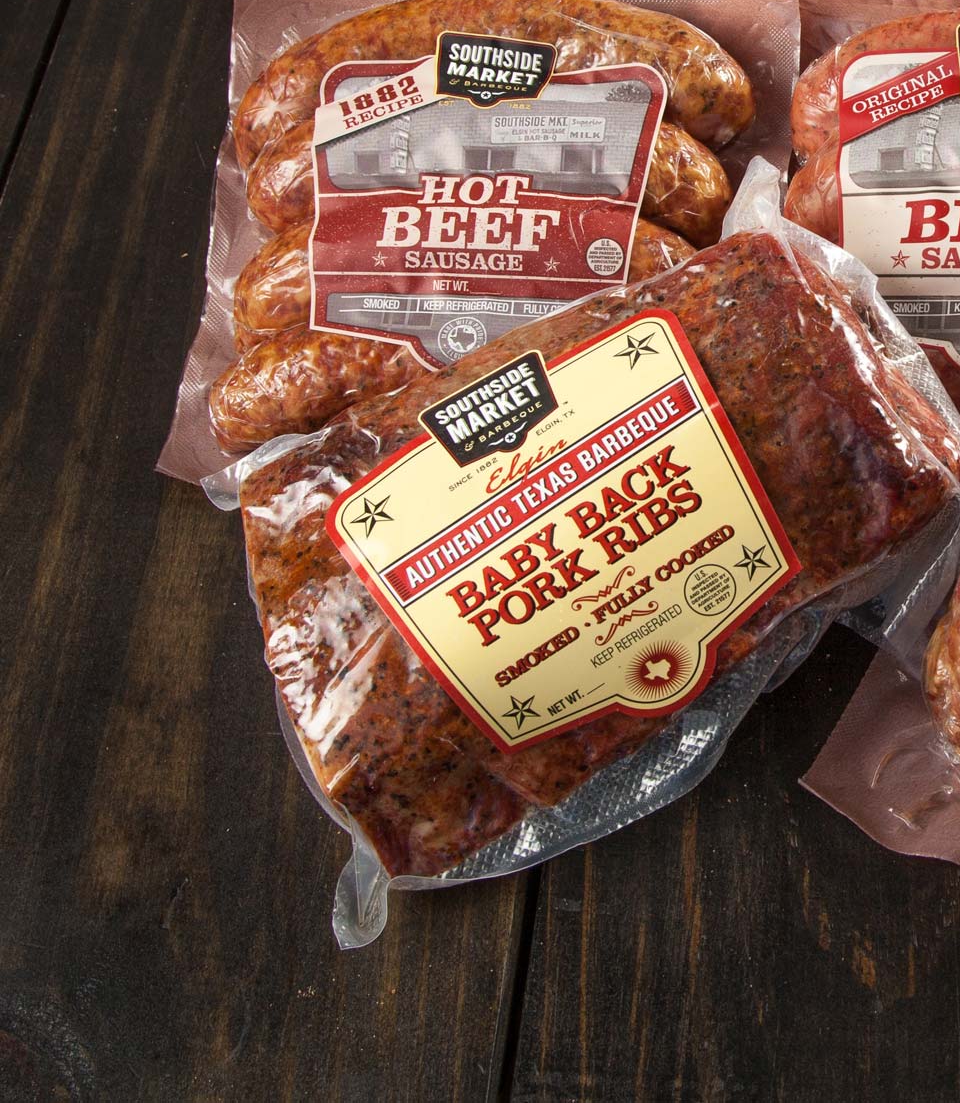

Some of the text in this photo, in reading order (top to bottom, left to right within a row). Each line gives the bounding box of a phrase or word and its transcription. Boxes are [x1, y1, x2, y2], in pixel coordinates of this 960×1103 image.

[447, 62, 538, 86] MARKET
[449, 43, 544, 73] SOUTHSIDE
[339, 75, 418, 116] 1882
[464, 81, 527, 91] BARBEQUE
[852, 65, 953, 115] ORIGINAL
[869, 84, 944, 123] RECIPE
[342, 94, 424, 130] RECIPE
[495, 117, 545, 127] SOUTHSIDE
[417, 175, 528, 204] HOT
[376, 206, 560, 252] BEEF
[405, 251, 523, 272] SAUSAGE
[433, 280, 469, 291] NET WT.
[364, 299, 399, 309] SMOKED
[424, 300, 508, 312] KEEP REFRIGERATED
[523, 304, 548, 314] FULLY
[894, 303, 930, 313] SMOKED
[434, 362, 535, 425] SOUTHSIDE
[446, 377, 541, 444] MARKET
[464, 401, 543, 451] & BARBEQUE
[536, 409, 575, 436] ELGIN, TX
[449, 457, 498, 492] SINCE 1882
[485, 437, 567, 493] Elgin
[404, 396, 680, 589] AUTHENTIC TEXAS BARBEQUE
[446, 444, 692, 618] BABY BACK
[466, 480, 703, 648] PORK RIBS
[494, 525, 735, 687] SMOKED FULLY COOKED
[591, 603, 682, 668] KEEP REFRIGERATED
[547, 689, 584, 716] NET WT.
